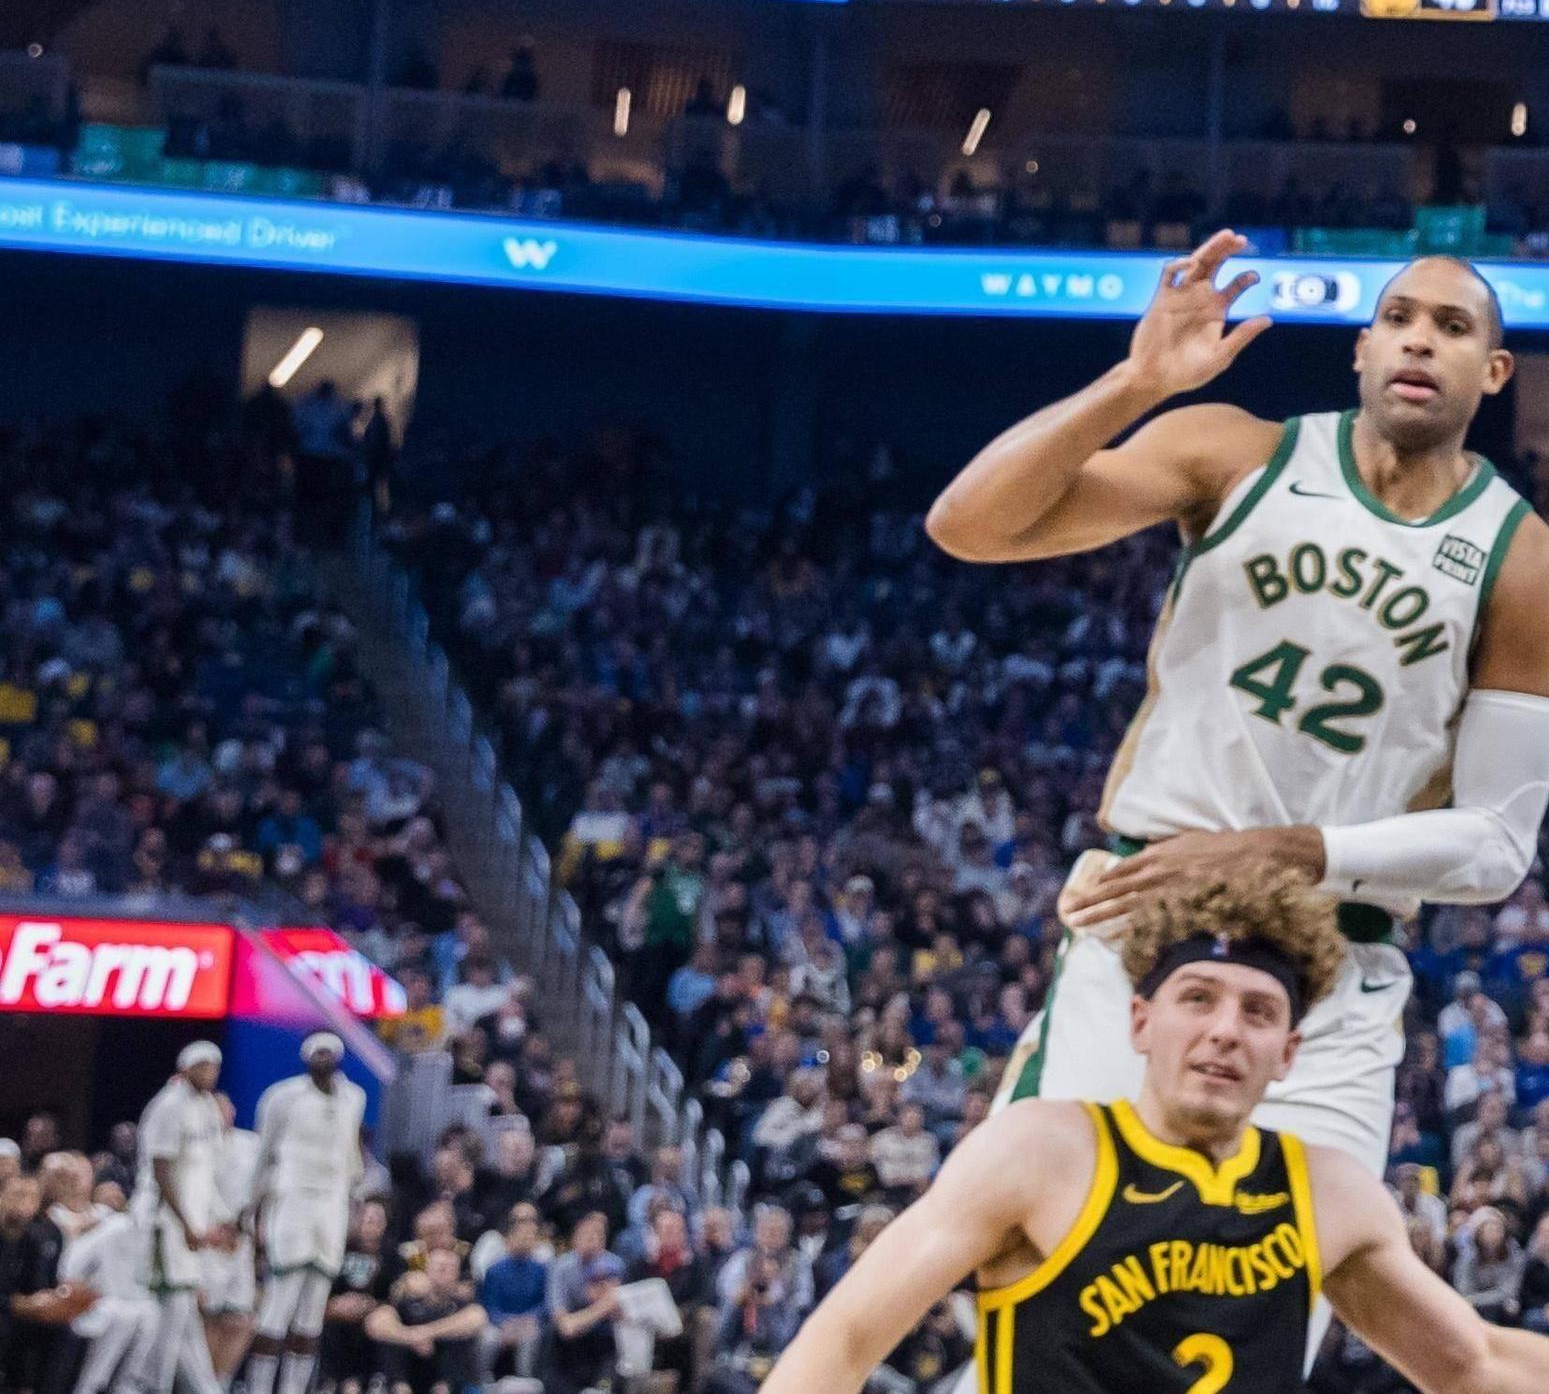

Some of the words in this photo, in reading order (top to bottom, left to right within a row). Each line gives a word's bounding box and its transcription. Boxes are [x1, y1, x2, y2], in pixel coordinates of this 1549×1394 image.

[53, 202, 243, 246] Experienced
[251, 215, 336, 252] Driver
[981, 271, 1124, 300] WAYMO
[1497, 280, 1547, 311] The
[1243, 541, 1448, 667] BOSTON
[1229, 639, 1386, 755] 42
[0, 921, 200, 1011] Farm
[1080, 1255, 1155, 1338] SAN
[1149, 1222, 1306, 1297] FRANCISCO
